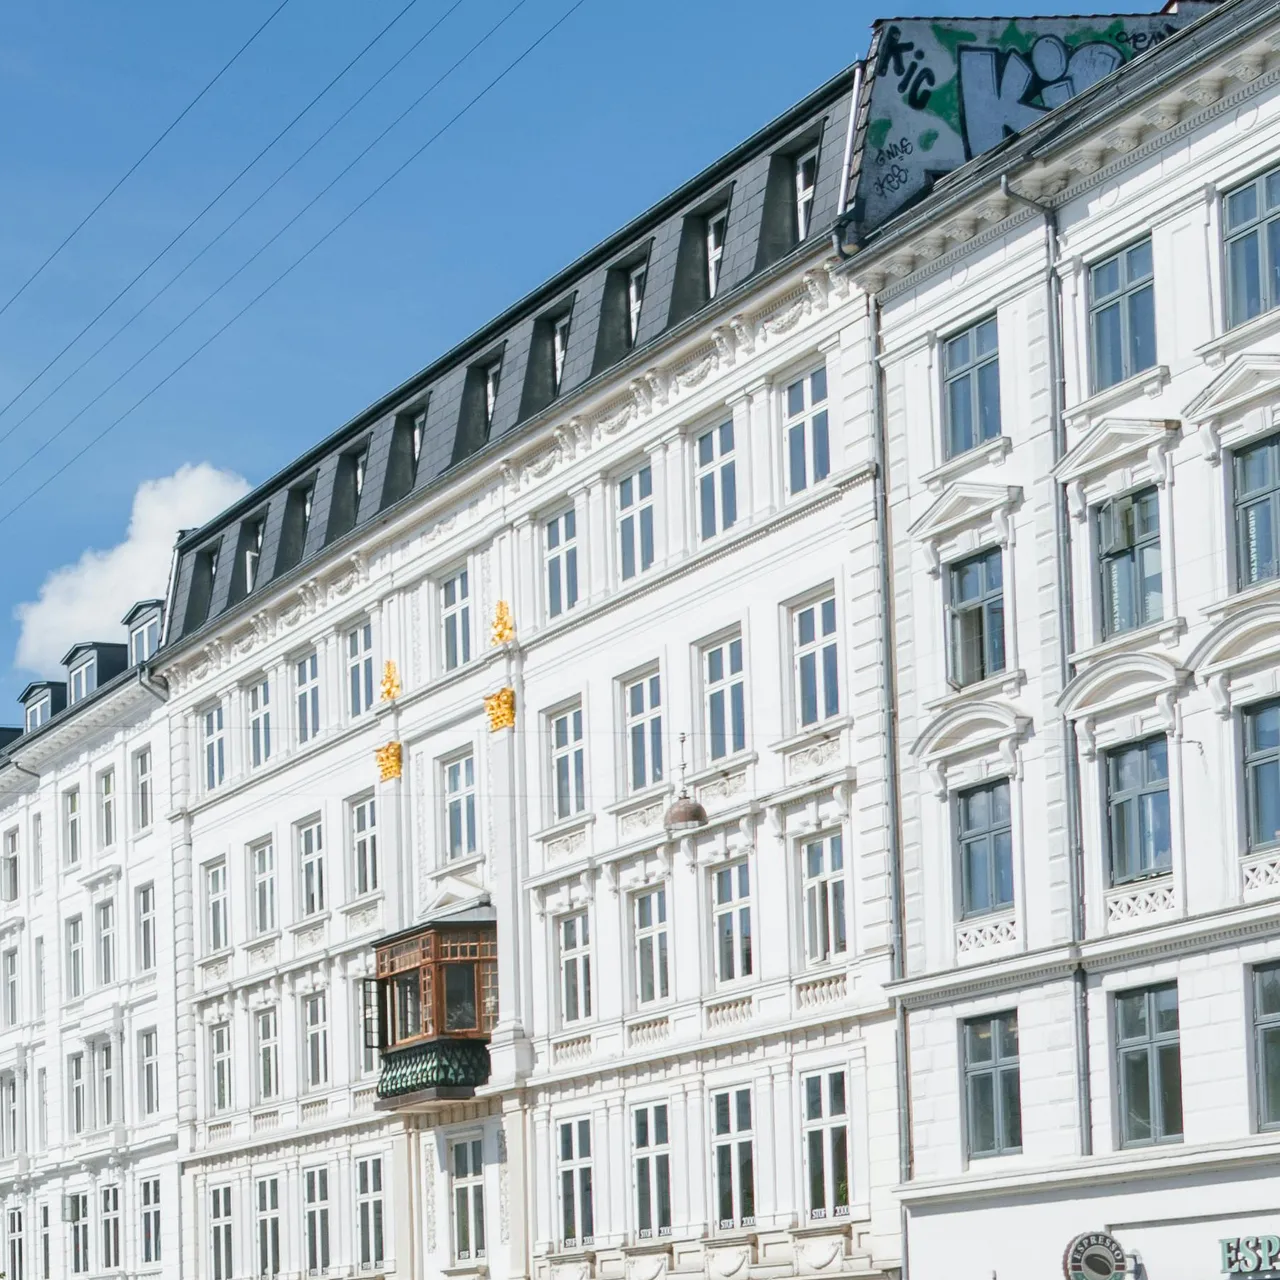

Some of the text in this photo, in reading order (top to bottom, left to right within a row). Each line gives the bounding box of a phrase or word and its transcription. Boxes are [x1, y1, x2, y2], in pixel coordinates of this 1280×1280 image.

[1248, 510, 1258, 582] KIROPRAKTOR
[1111, 564, 1120, 632] KIROPRAKTOR
[1072, 1235, 1123, 1260] ESPRESSO
